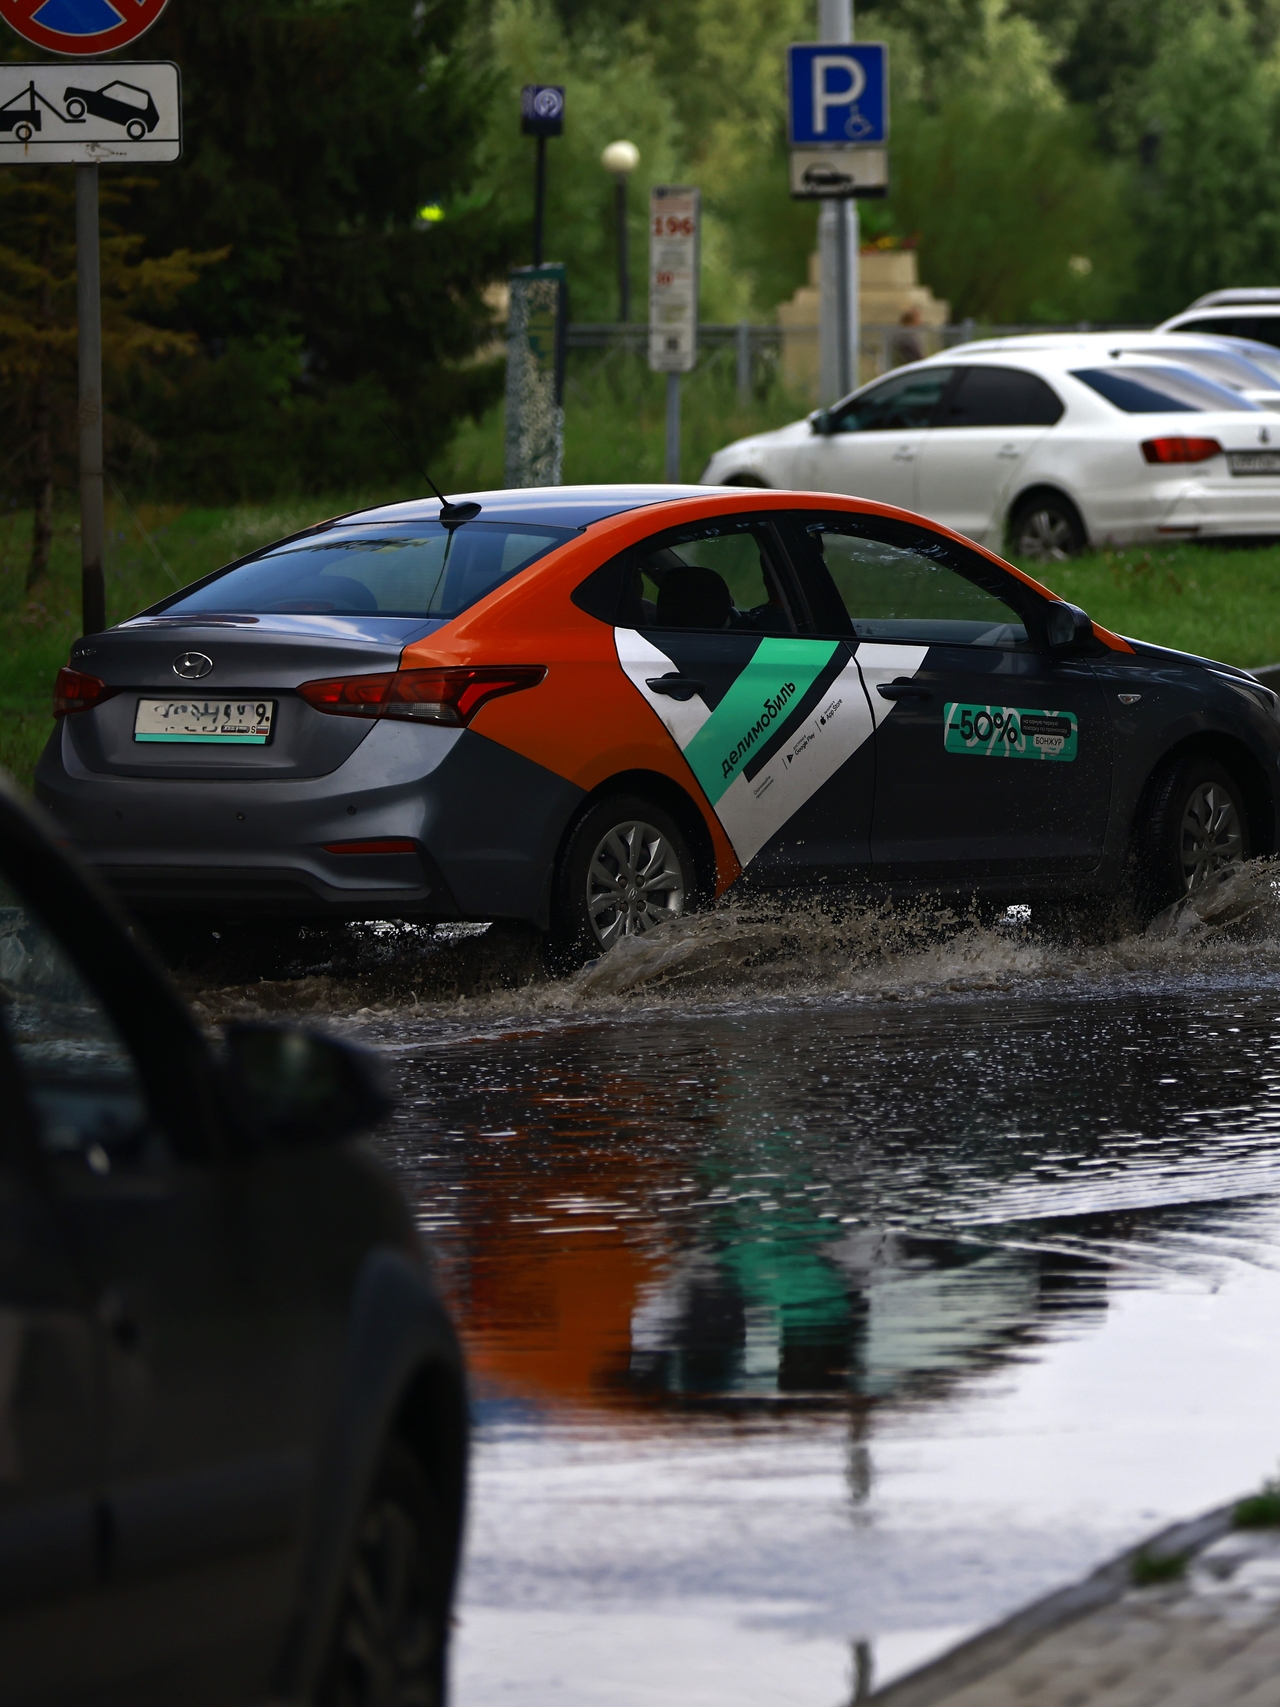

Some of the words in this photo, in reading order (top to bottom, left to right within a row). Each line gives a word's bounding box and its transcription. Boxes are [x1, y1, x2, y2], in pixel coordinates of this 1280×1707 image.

[811, 55, 867, 134] P
[721, 681, 796, 779] делимобиль
[949, 710, 1018, 743] -50%
[1035, 737, 1063, 746] БОНЖУР
[795, 740, 808, 755] Google
